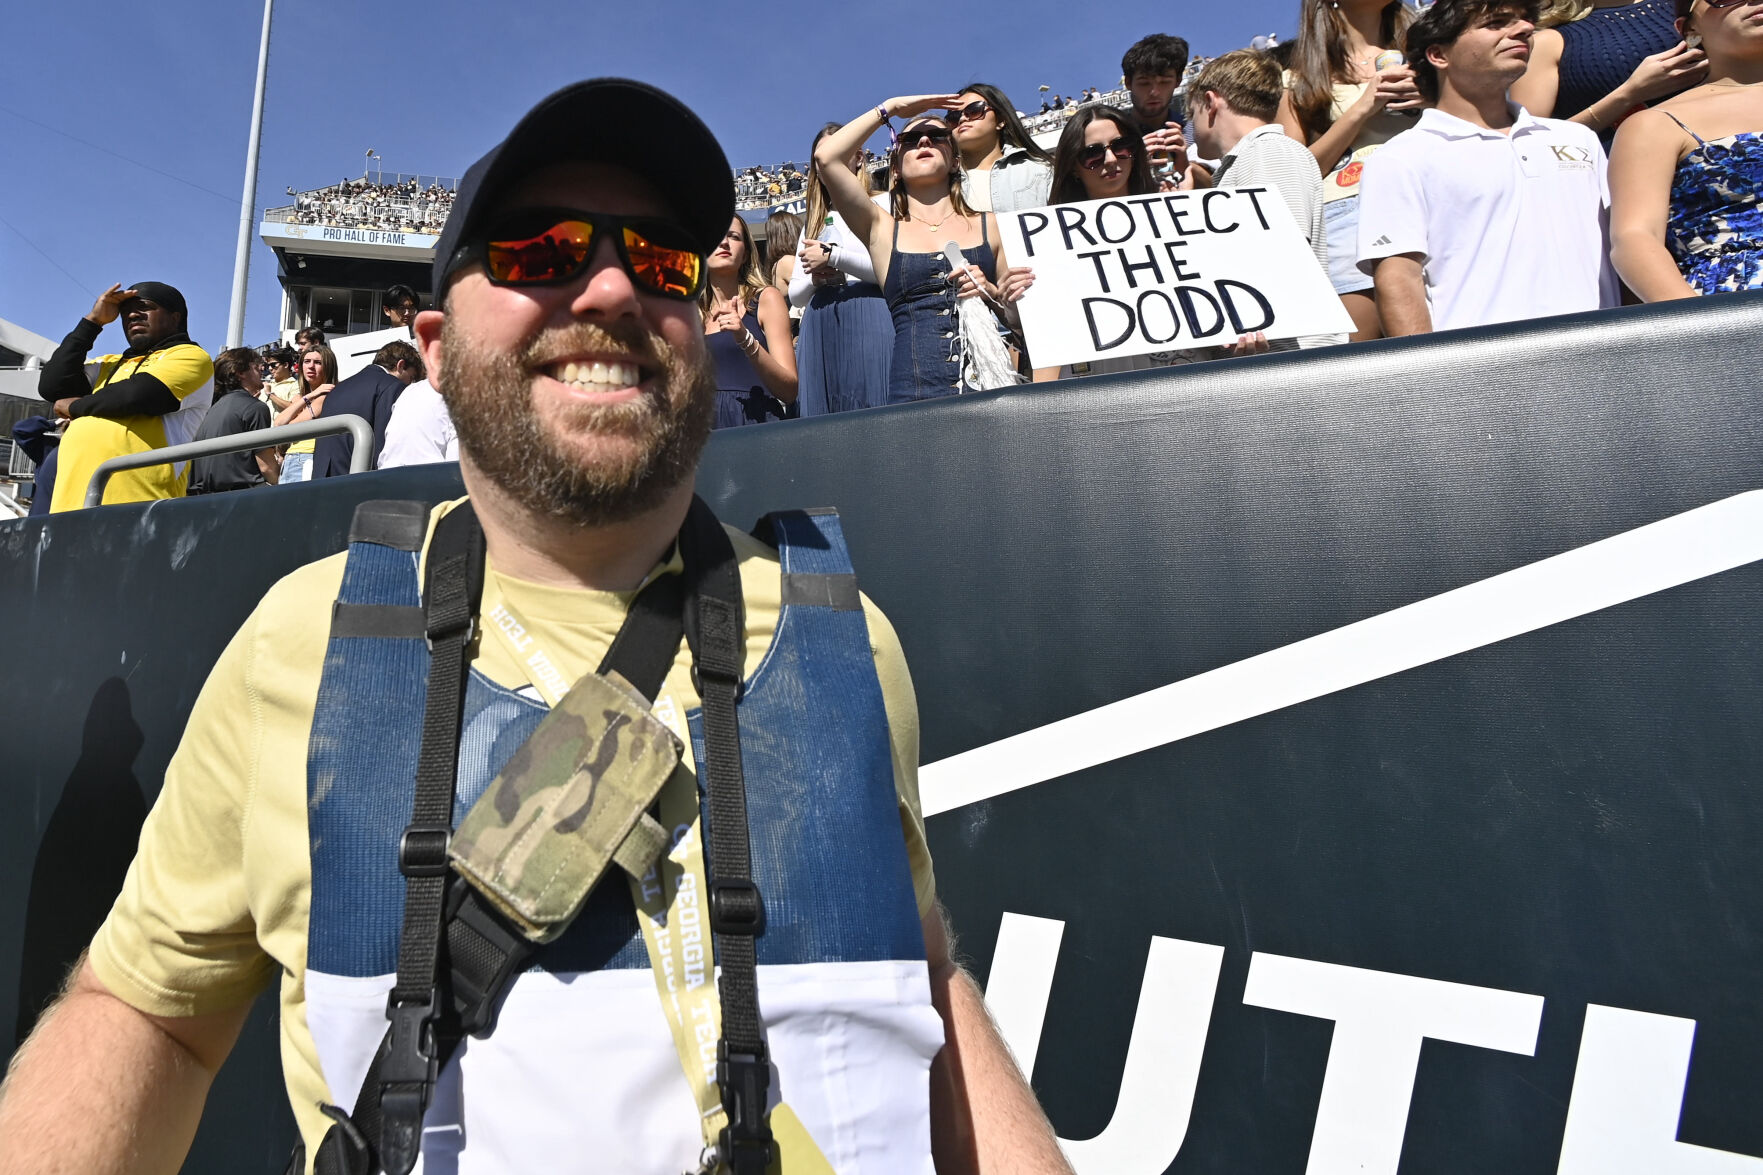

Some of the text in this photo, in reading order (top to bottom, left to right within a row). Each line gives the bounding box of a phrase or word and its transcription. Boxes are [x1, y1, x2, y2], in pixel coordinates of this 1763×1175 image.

[774, 200, 806, 215] CAL
[1017, 187, 1271, 257] PROTECT
[323, 228, 406, 245] PRO HALL OF FAME
[1077, 240, 1202, 294] THE
[1081, 279, 1276, 352] DODD
[489, 603, 534, 653] TECH
[675, 872, 705, 993] GEORGIA
